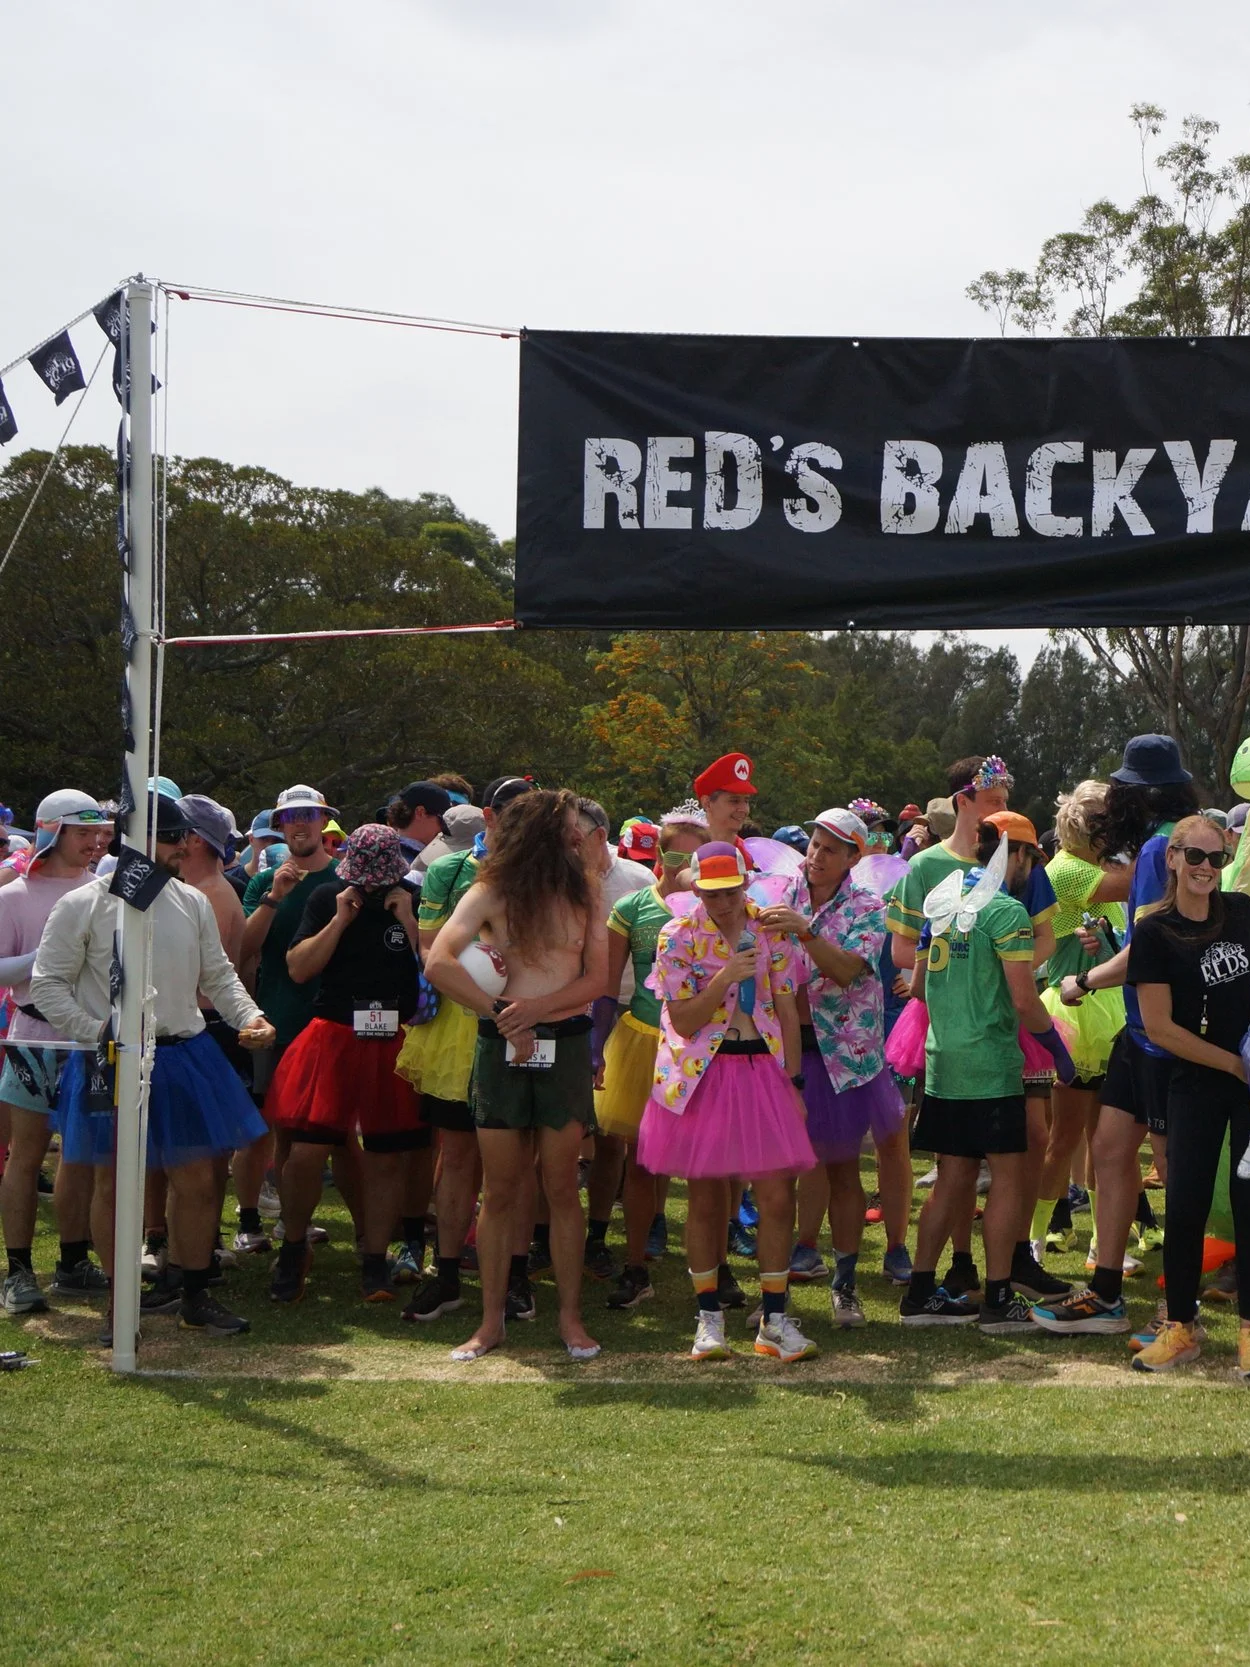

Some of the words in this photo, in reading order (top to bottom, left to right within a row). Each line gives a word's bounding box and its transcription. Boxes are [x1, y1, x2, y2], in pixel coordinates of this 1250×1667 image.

[583, 431, 843, 533] RED'S
[736, 764, 748, 776] M
[370, 1011, 382, 1023] 51
